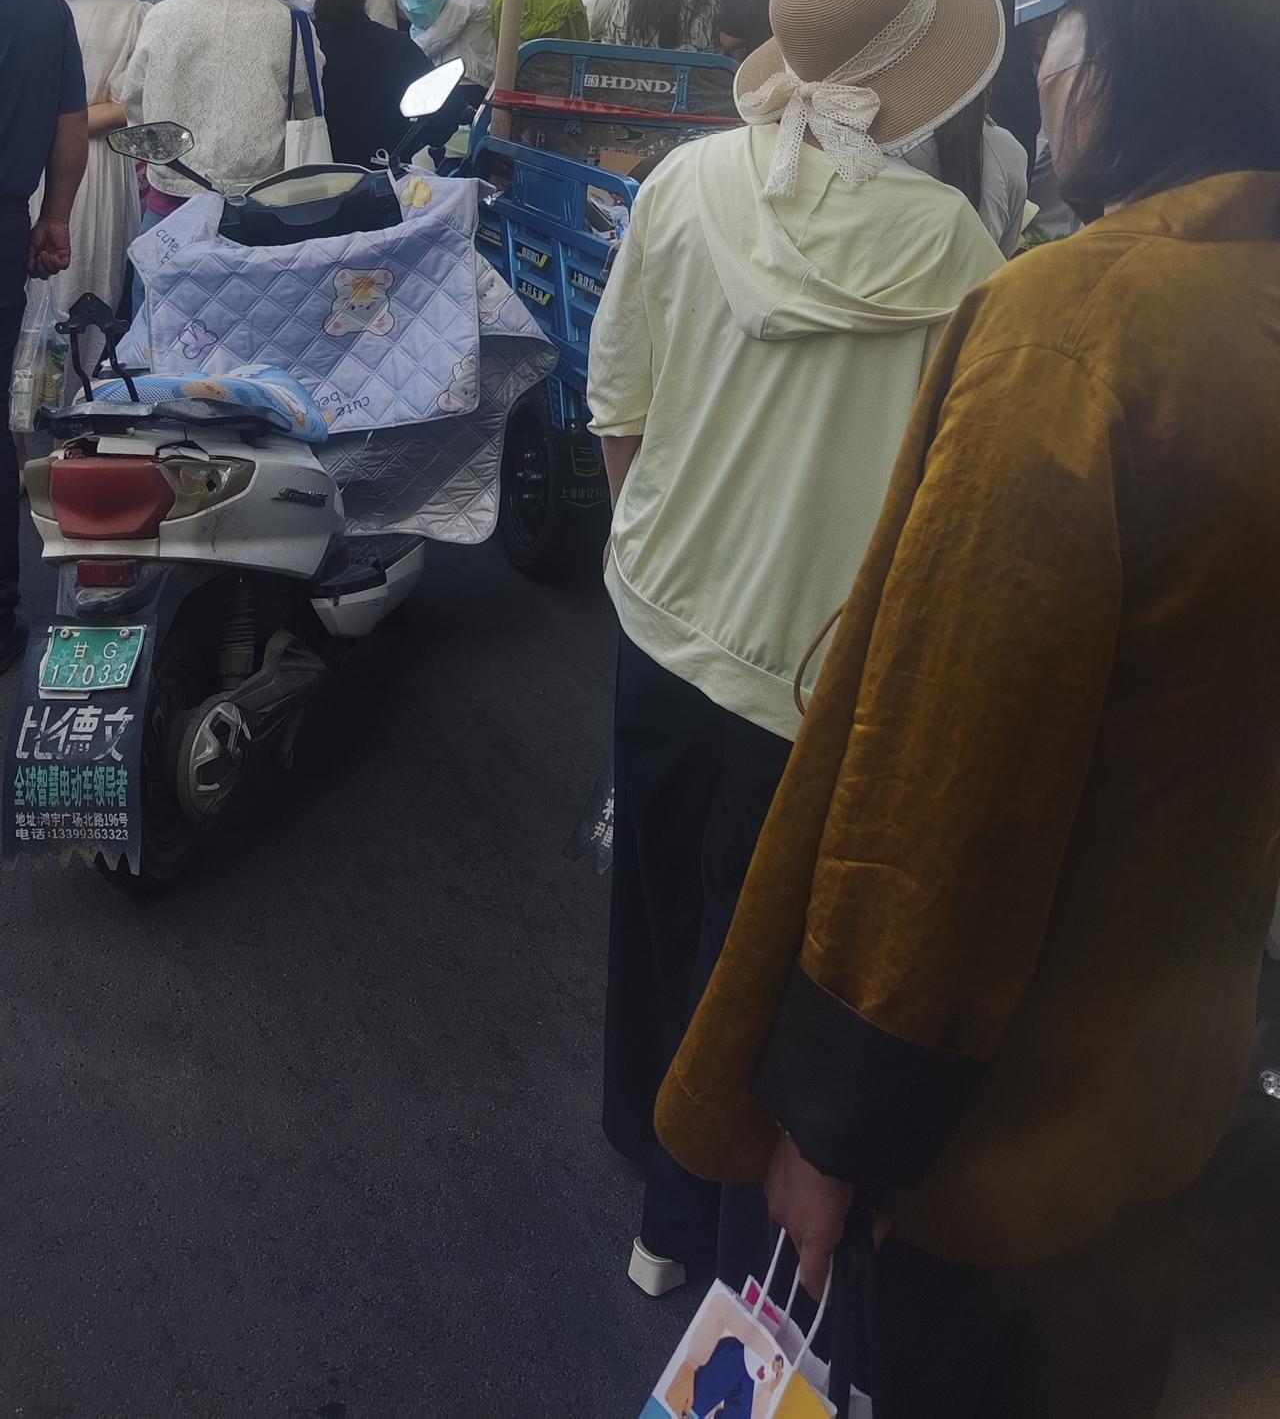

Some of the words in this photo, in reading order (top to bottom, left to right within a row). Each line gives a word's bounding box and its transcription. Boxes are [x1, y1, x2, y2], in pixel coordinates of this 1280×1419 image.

[156, 229, 180, 254] cute
[50, 663, 128, 686] 17033
[16, 705, 134, 762] 比德文
[14, 764, 128, 807] 全球智慧电动车领导者
